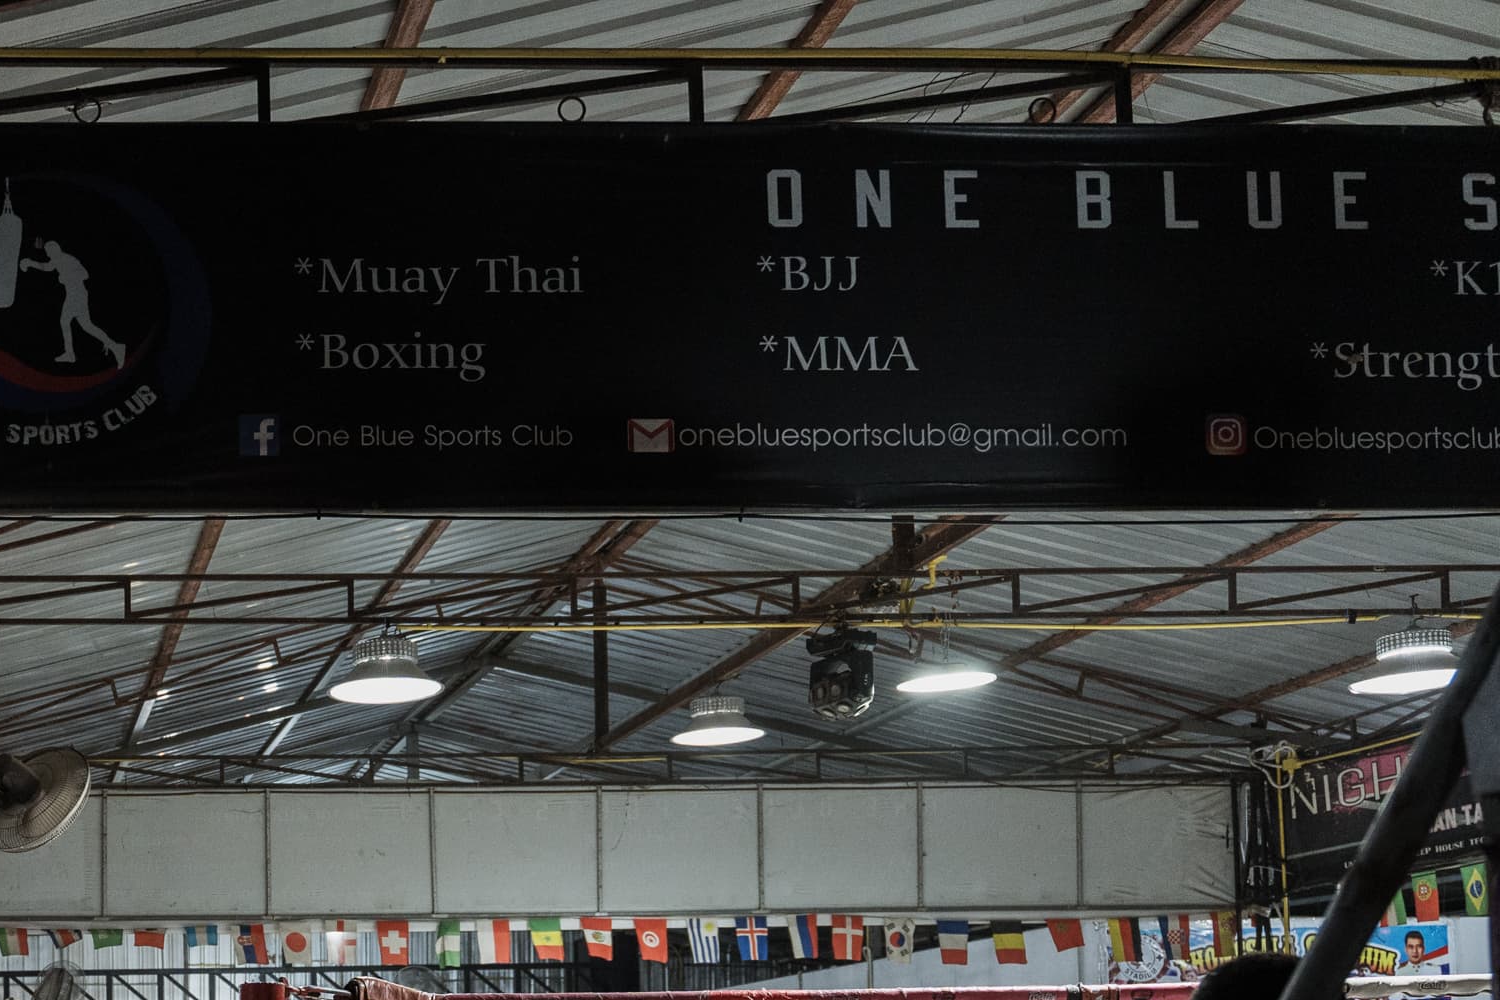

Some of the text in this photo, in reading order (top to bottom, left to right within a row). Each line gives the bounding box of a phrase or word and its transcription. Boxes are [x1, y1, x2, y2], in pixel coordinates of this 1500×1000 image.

[767, 168, 981, 229] ONE
[1076, 170, 1369, 231] BLUE
[476, 255, 584, 294] Thai
[5, 384, 159, 446] SPORTS CLUB
[293, 424, 573, 451] One Blue Sports Club
[680, 423, 1129, 453] onebluesportsclub@gmail.com
